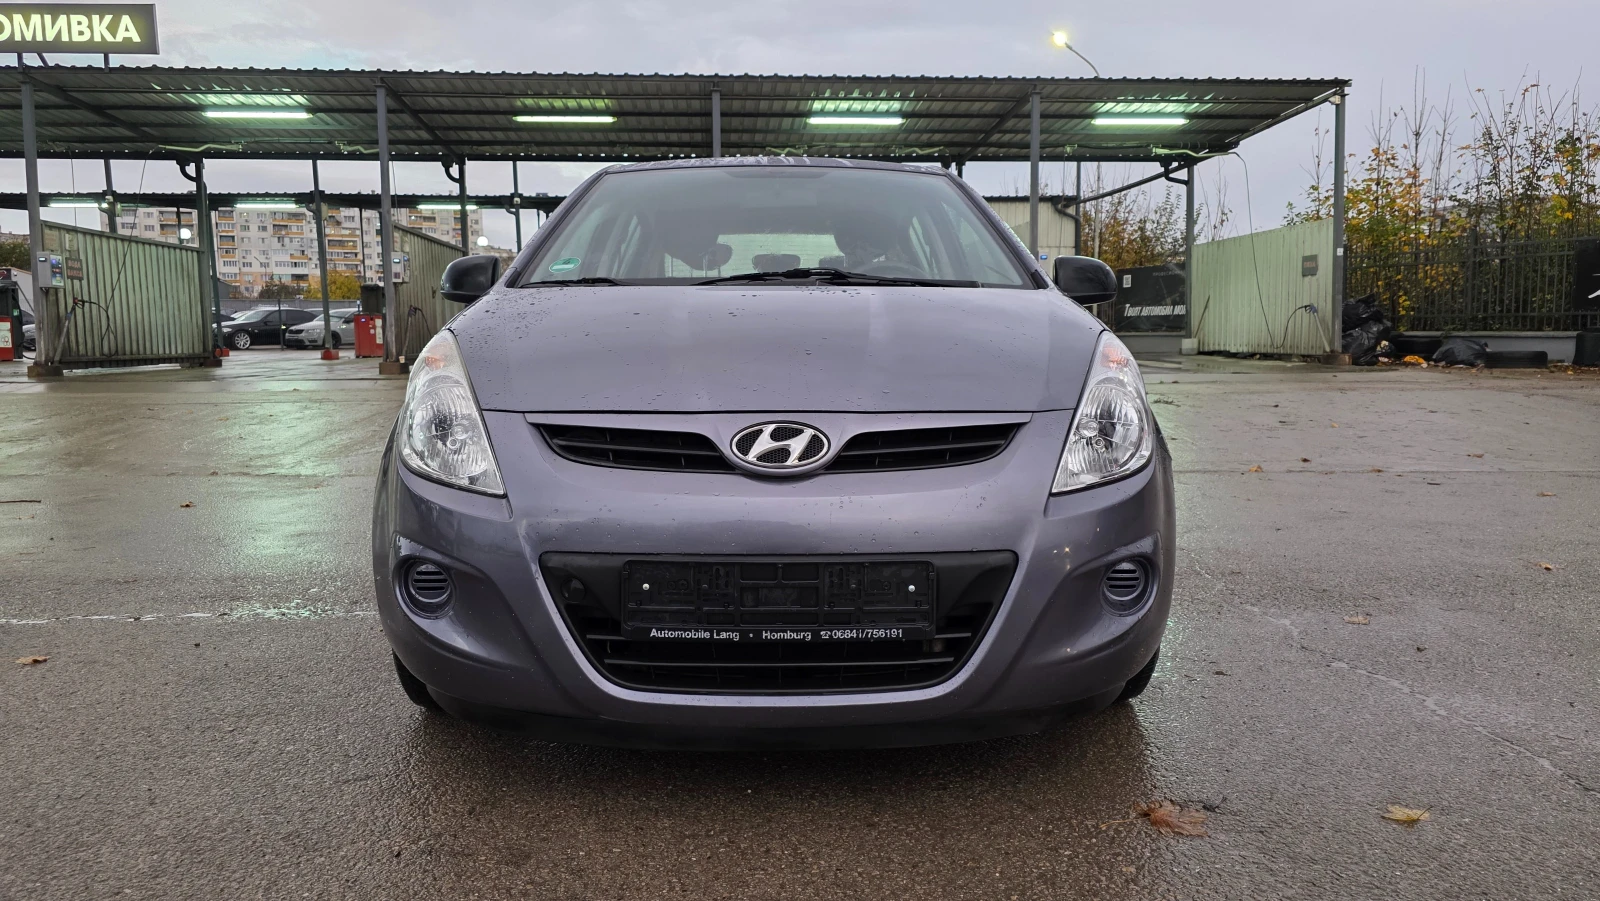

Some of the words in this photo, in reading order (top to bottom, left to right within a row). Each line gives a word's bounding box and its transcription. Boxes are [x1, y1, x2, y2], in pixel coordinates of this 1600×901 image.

[650, 628, 711, 639] Automobile
[713, 629, 739, 641] Lang
[762, 630, 812, 641] Homburg
